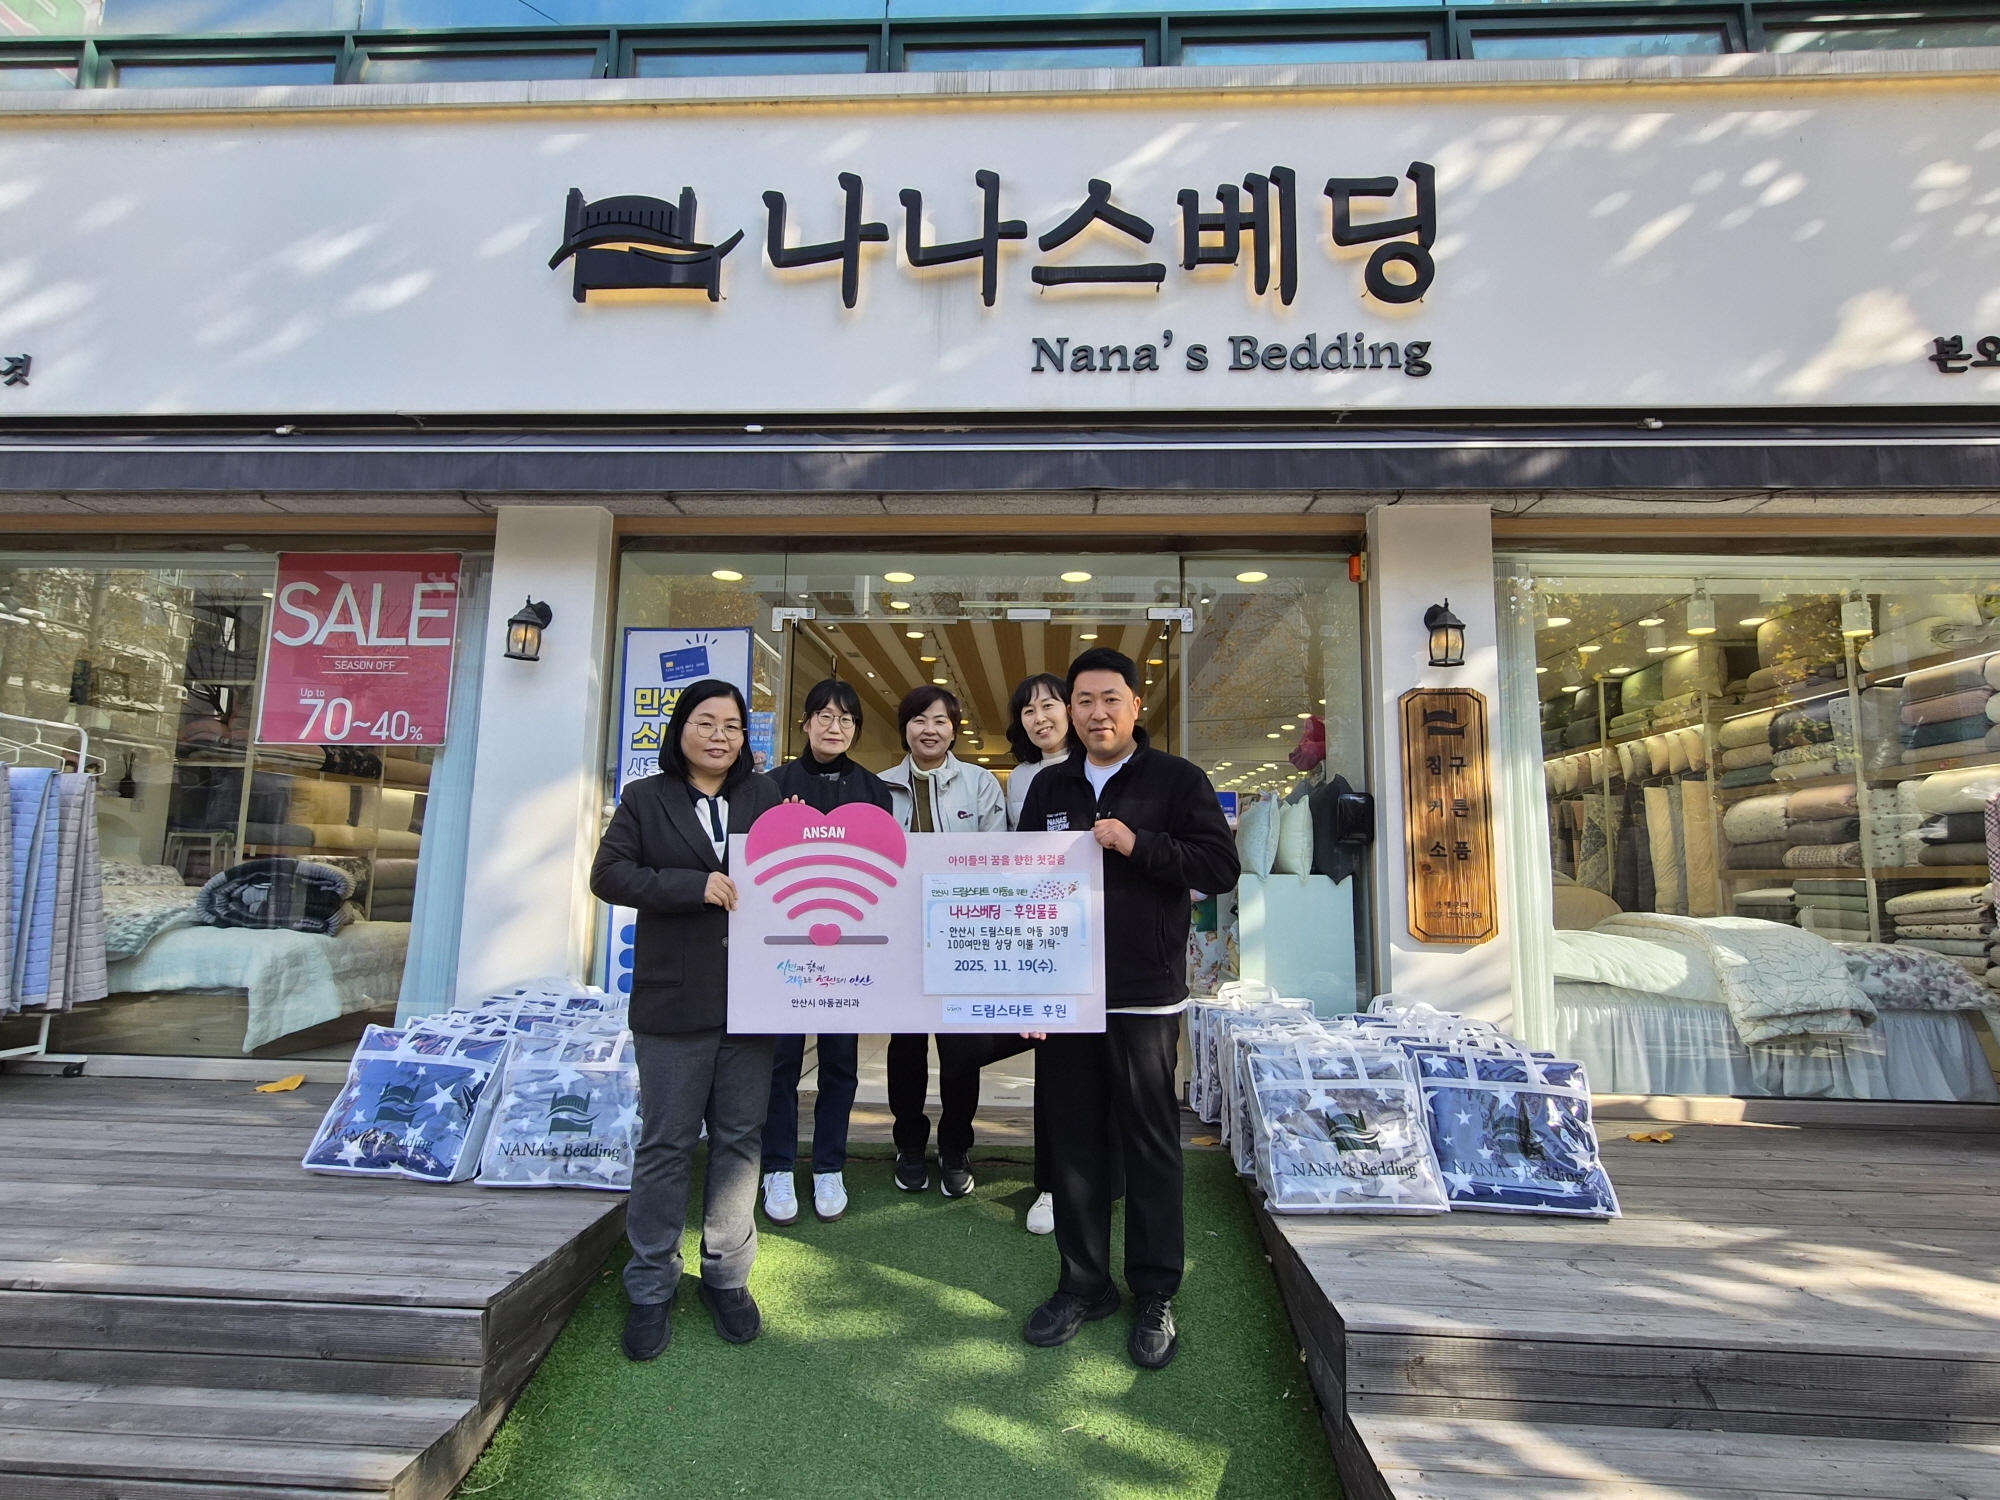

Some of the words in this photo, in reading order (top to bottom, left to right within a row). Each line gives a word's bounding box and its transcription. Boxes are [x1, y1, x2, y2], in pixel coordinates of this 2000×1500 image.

[761, 162, 1437, 309] 나나스베딩
[1031, 330, 1209, 373] Nana's
[1228, 332, 1432, 377] Bedding
[273, 581, 456, 647] SALE
[334, 661, 374, 670] SEASON
[376, 661, 396, 670] OFF
[300, 687, 314, 698] Up
[316, 688, 325, 697] to
[1426, 755, 1468, 776] 침구
[1428, 798, 1470, 817] 커튼
[803, 826, 846, 839] ANSAN
[1429, 841, 1471, 861] 소품
[948, 855, 987, 867] 아이들의
[990, 855, 1010, 866] 꿈을
[1013, 855, 1033, 866] 향한
[1037, 855, 1066, 866] 첫걸음
[952, 887, 990, 897] 드림스타트
[992, 886, 1014, 897] 아동을
[949, 904, 1001, 920] 나나스베딩
[1013, 903, 1059, 919] 후원물품
[949, 926, 975, 938] 안산시
[980, 926, 1022, 938] 드림스타트
[1027, 926, 1044, 938] 아동
[1049, 926, 1069, 937] 30명
[947, 939, 990, 950] 100여만원
[995, 939, 1012, 950] 상당
[1017, 939, 1034, 950] 이불
[954, 959, 987, 972] 2025.
[994, 959, 1011, 972] 11.
[1018, 958, 1057, 973] 19(수).
[849, 975, 875, 986] 안산
[791, 999, 815, 1008] 안산시
[818, 999, 860, 1008] 아동권리과
[971, 1004, 1034, 1018] 드림스타트
[1041, 1003, 1067, 1018] 후원
[497, 1141, 558, 1157] NANA's
[1291, 1161, 1356, 1176] NANA's
[1360, 1160, 1418, 1179] Bedding
